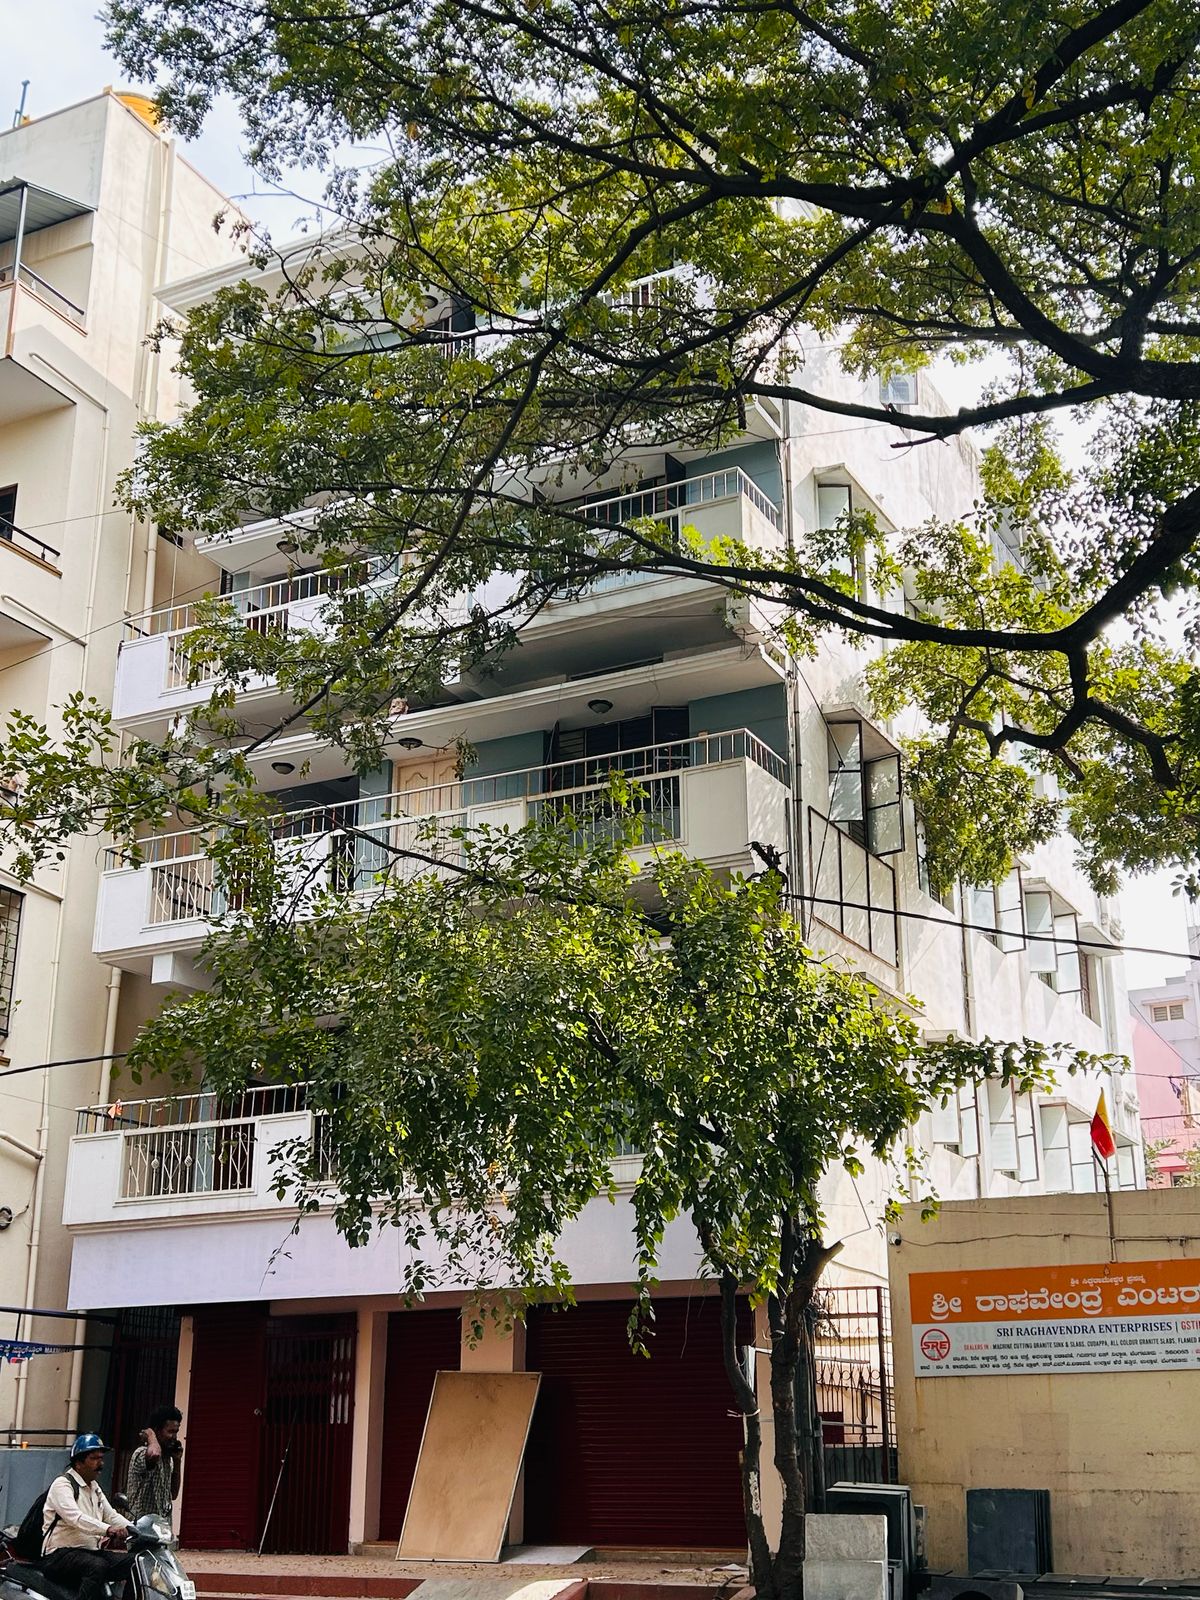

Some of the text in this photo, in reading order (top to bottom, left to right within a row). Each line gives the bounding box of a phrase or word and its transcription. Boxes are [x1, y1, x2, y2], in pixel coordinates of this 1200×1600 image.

[930, 1293, 962, 1320] ಶ್ರೀ
[975, 1286, 1103, 1315] ರಾಘವೇಂದ್ರ
[997, 1328, 1013, 1337] SRI
[1016, 1324, 1096, 1337] RAGHAVENDRA
[1100, 1321, 1172, 1334] ENTERPRISES
[1034, 1341, 1052, 1349] GRANITE
[1120, 1338, 1138, 1346] COLOUR
[1178, 1336, 1197, 1344] FLAMED
